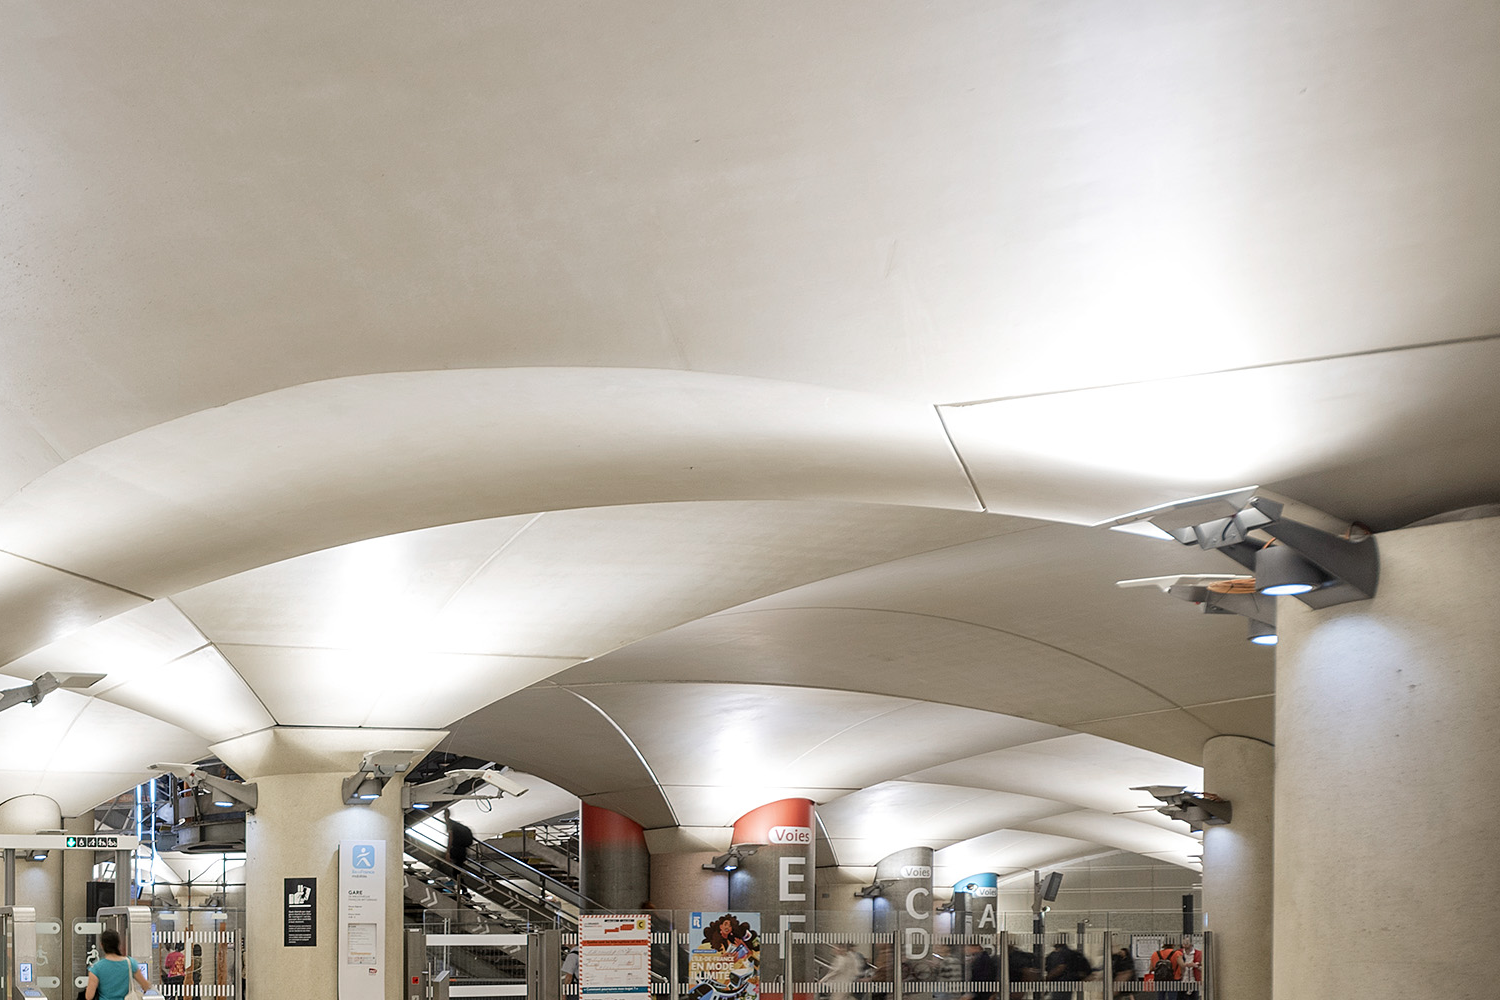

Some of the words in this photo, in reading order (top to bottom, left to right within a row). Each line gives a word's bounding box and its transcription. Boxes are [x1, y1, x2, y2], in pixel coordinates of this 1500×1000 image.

[774, 829, 810, 843] Voies
[778, 857, 806, 902] E
[905, 868, 930, 877] Voies
[906, 888, 930, 920] C
[978, 904, 996, 928] A
[905, 928, 930, 960] D
[691, 962, 704, 970] EN
[706, 962, 734, 970] MODE
[691, 970, 730, 980] ILLIMITÉ
